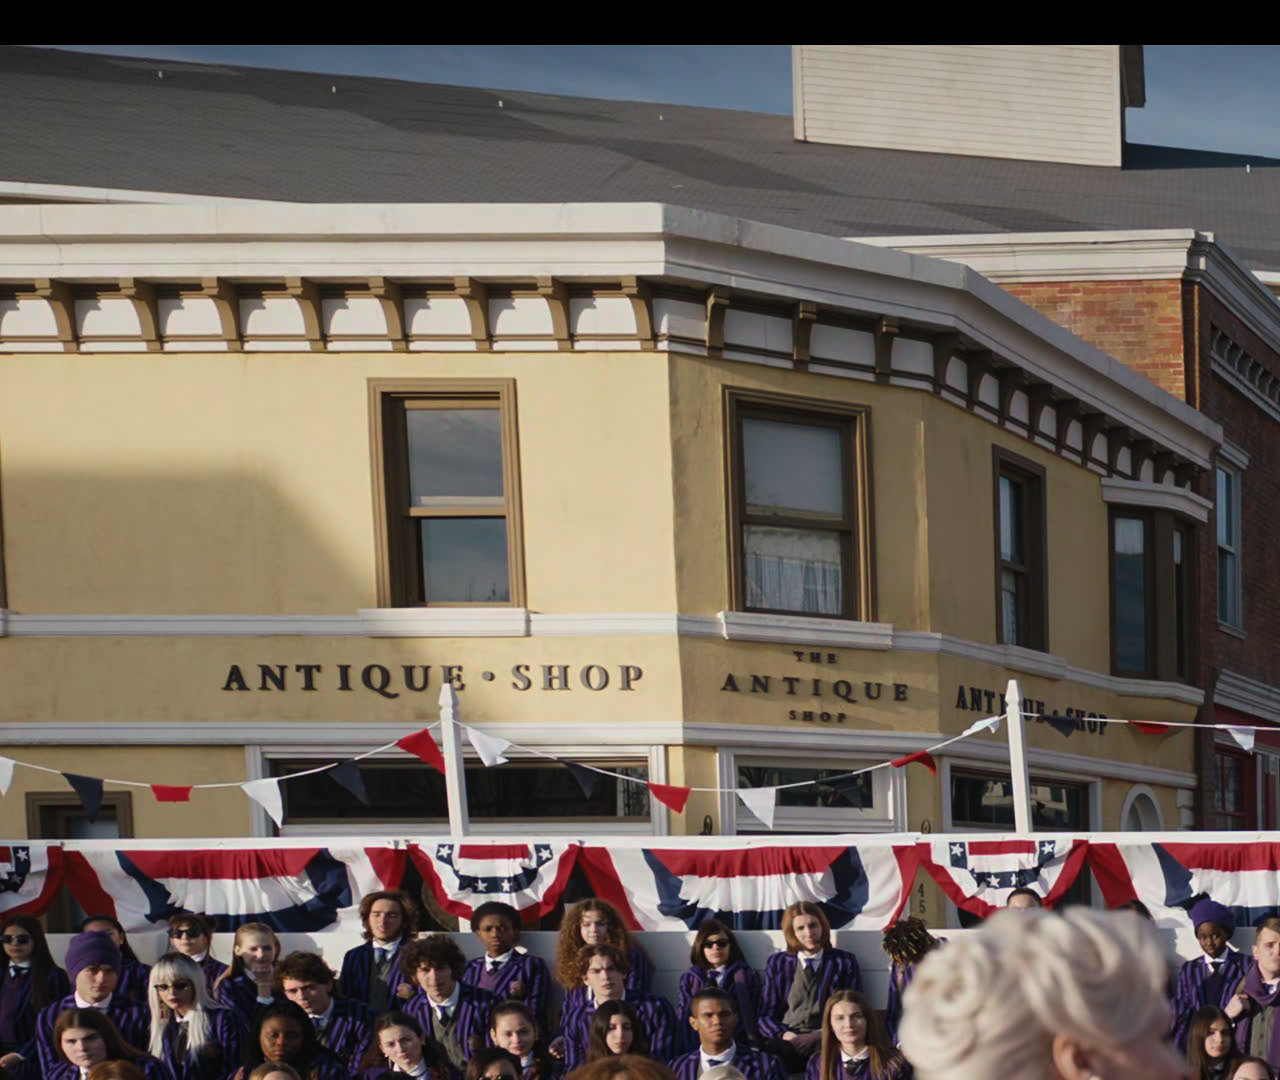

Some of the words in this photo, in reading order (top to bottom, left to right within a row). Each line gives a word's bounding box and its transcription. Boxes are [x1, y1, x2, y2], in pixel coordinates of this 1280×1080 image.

[793, 651, 837, 664] THE
[220, 664, 466, 699] ANTIQUE
[511, 663, 645, 691] SHOP
[720, 673, 910, 704] ANTIQUE
[788, 710, 848, 724] SHOP
[955, 685, 1046, 723] ANTIUE
